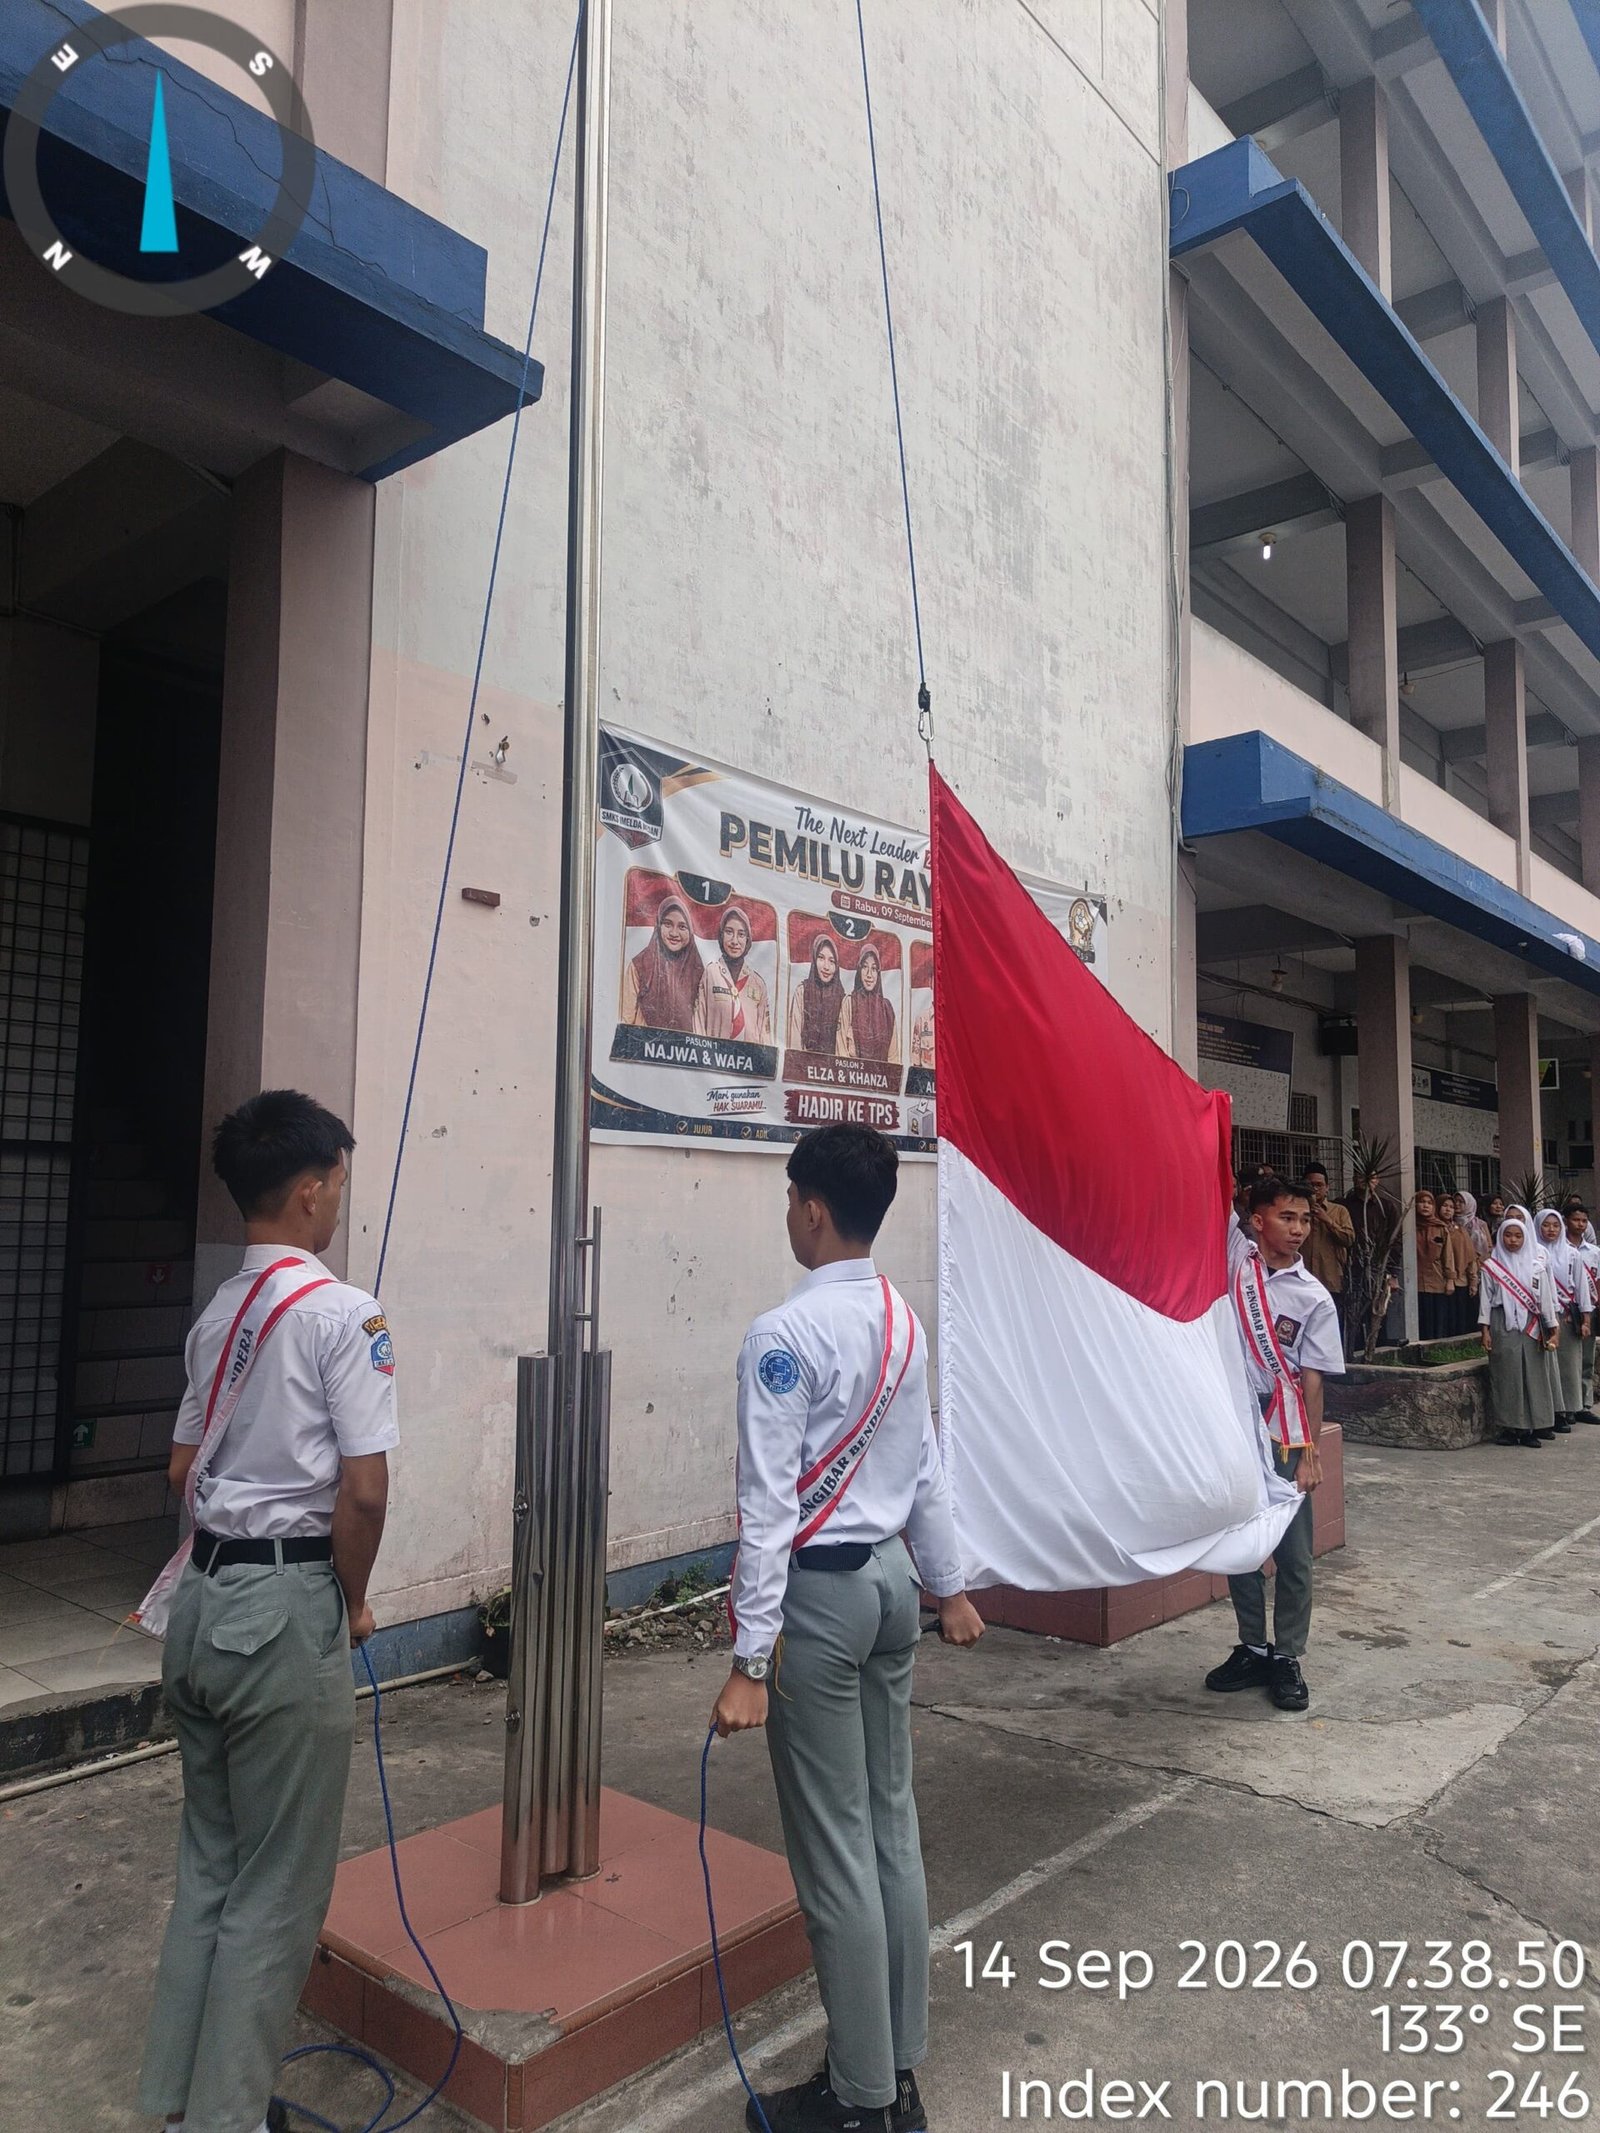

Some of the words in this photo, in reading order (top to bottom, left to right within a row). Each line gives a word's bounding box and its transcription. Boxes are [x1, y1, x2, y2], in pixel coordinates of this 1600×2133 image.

[601, 810, 619, 823] SMKS
[794, 806, 825, 835] The
[829, 816, 868, 849] Next
[869, 830, 919, 864] Leader
[720, 811, 865, 893] PEMILU
[702, 881, 711, 901] 1
[855, 899, 879, 916] Rabu,
[881, 905, 893, 917] 09
[845, 919, 855, 937] 2
[685, 1036, 713, 1049] PASLON
[714, 1041, 718, 1050] 1
[644, 1042, 698, 1064] NAJWA
[702, 1050, 711, 1066] &
[714, 1052, 753, 1072] WAFA
[835, 1059, 859, 1070] PASLON
[860, 1062, 865, 1070] 2
[807, 1066, 834, 1082] ELZA
[837, 1070, 846, 1083] &
[849, 1071, 888, 1089] KHANZA
[706, 1090, 729, 1102] Mari
[730, 1089, 760, 1102] gunakan
[713, 1101, 729, 1112] HAK
[798, 1094, 843, 1121] HADIR
[847, 1100, 865, 1122] KE
[868, 1102, 893, 1126] TPS
[693, 1124, 713, 1135] JUJUR
[1245, 1284, 1264, 1332] PENGIBAR
[1257, 1332, 1282, 1375] BENDERA
[228, 1328, 254, 1393] NDERA
[848, 1386, 893, 1457] BENDERA
